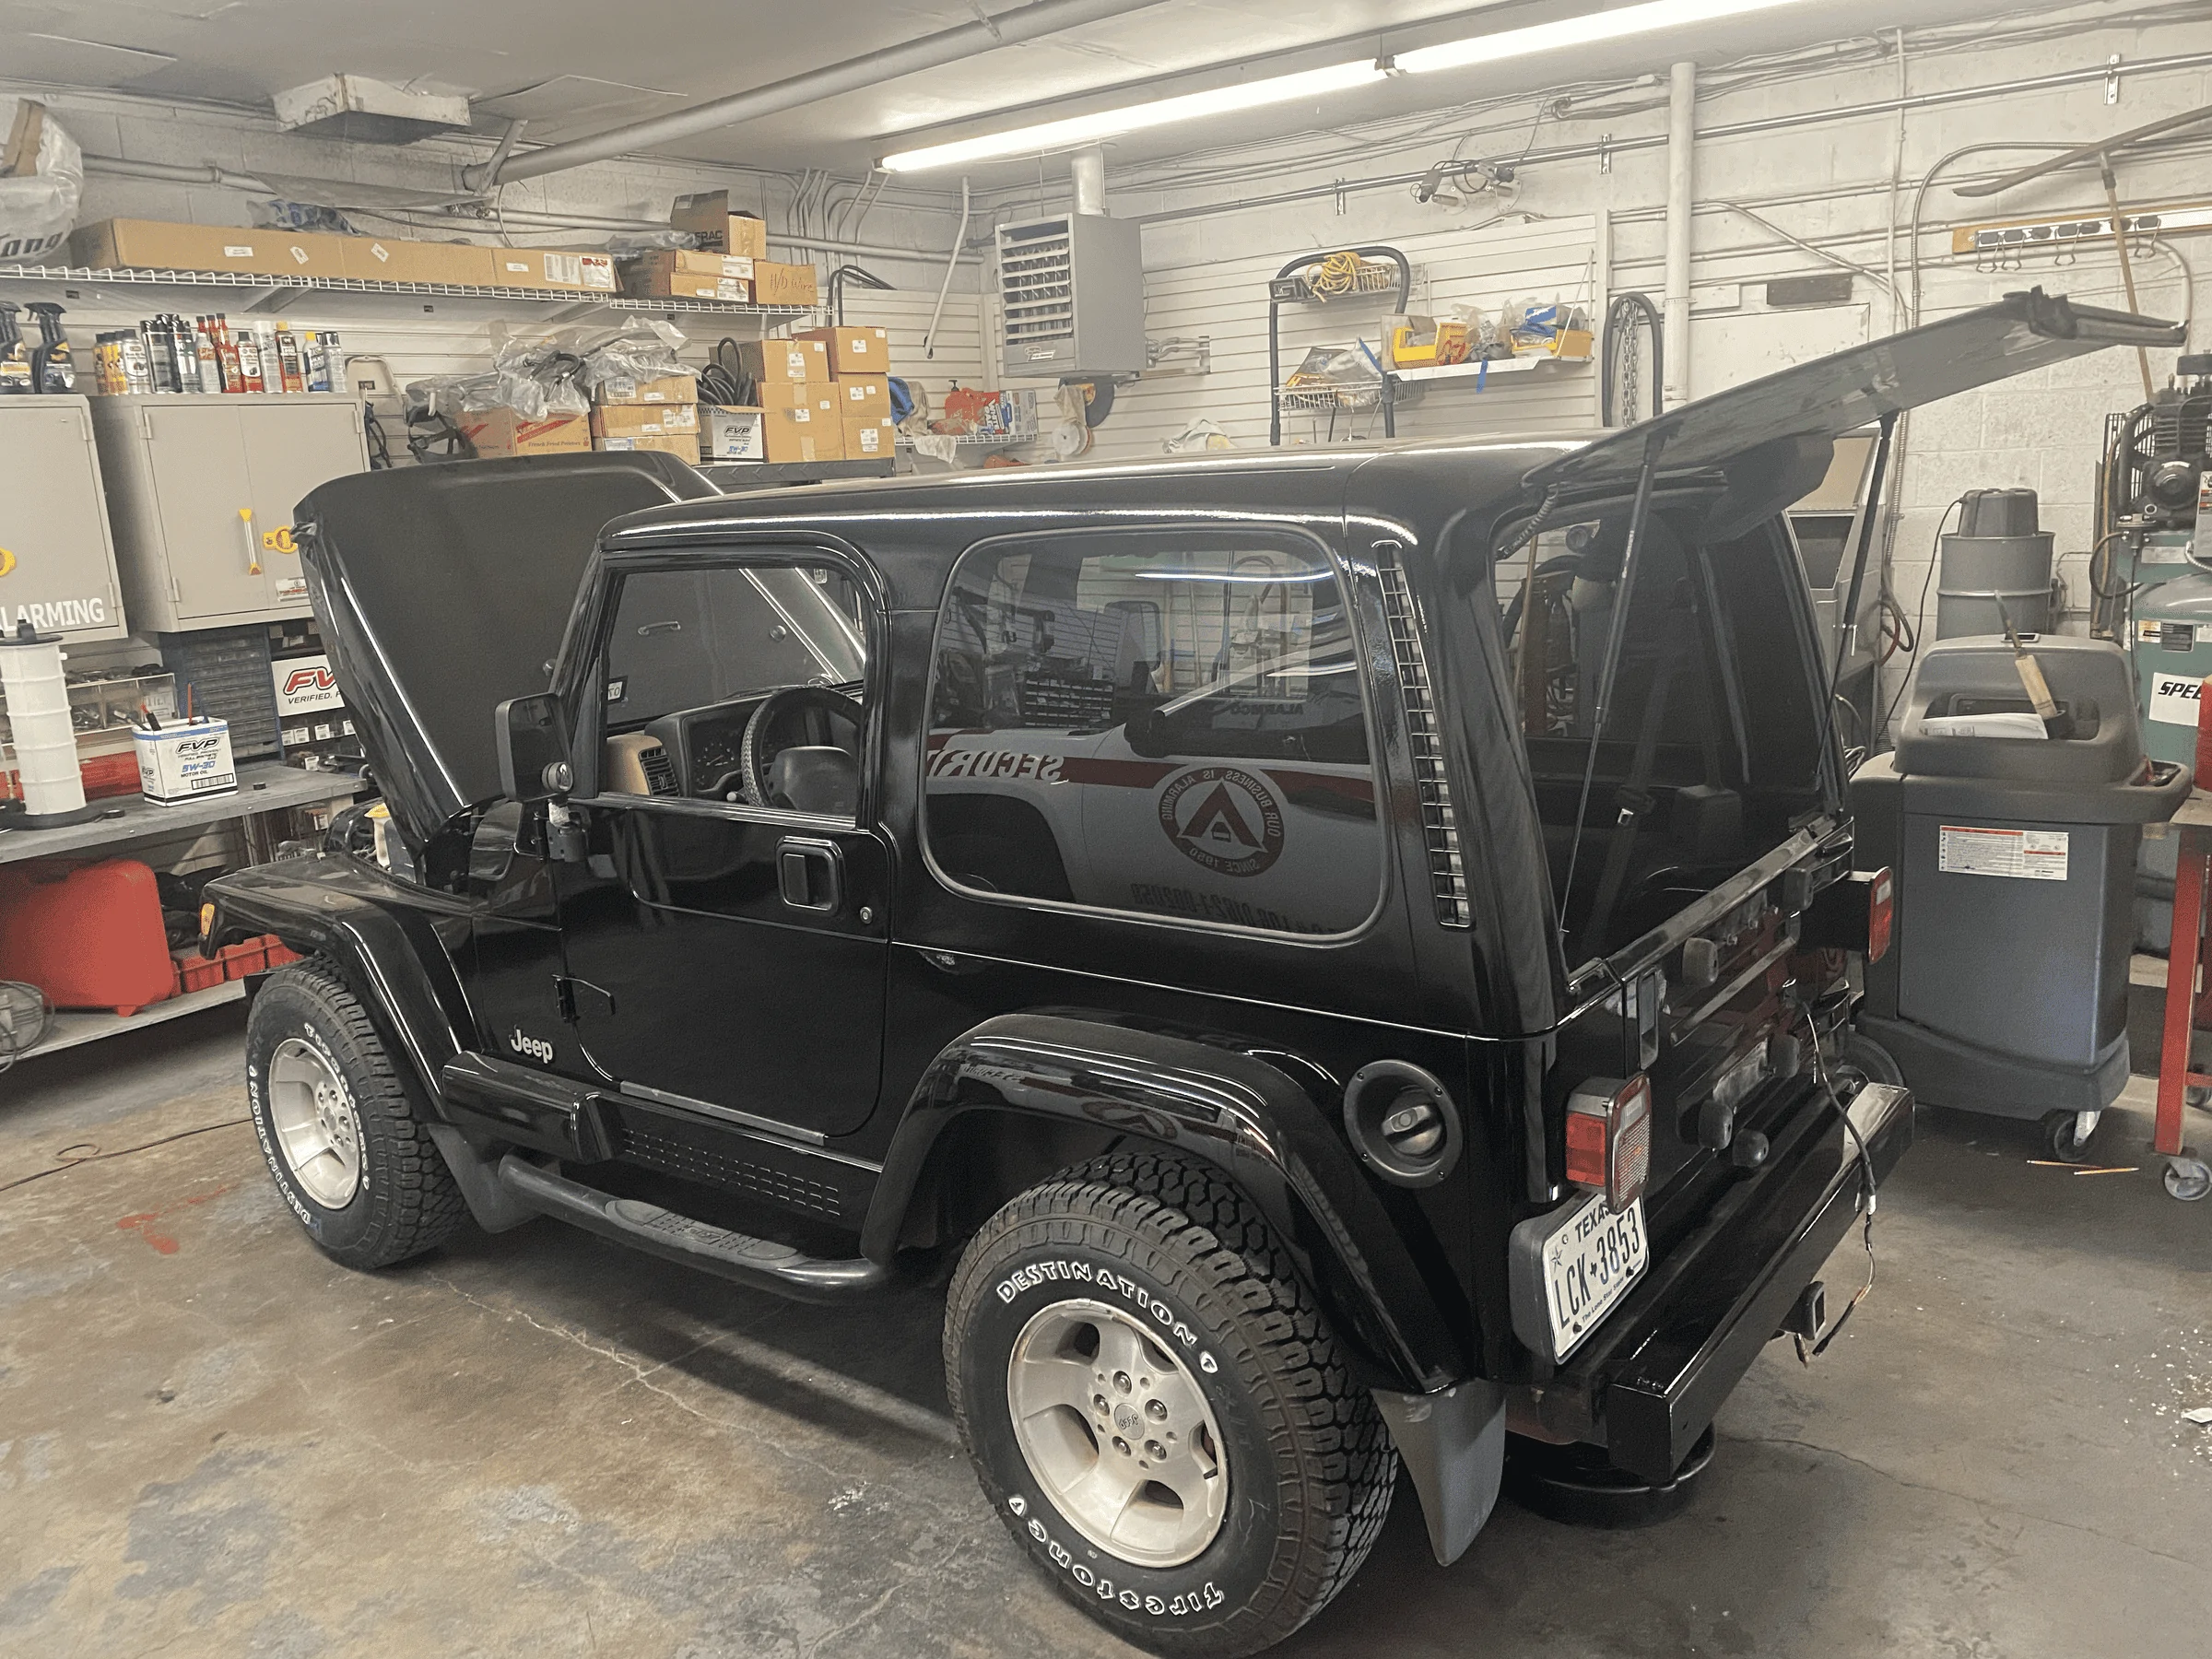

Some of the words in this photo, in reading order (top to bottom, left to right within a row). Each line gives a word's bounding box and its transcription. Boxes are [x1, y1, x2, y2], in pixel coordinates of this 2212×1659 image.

[0, 597, 105, 632] LARMING
[288, 692, 332, 704] VERIFIED.
[177, 738, 218, 753] FVP
[182, 760, 216, 772] 5W-30
[511, 1029, 553, 1064] Jeep
[249, 1080, 311, 1225] DESTINATION
[996, 1260, 1198, 1347] DESTINATION
[1592, 1300, 1603, 1313] Lone
[1603, 1288, 1613, 1300] Star
[1028, 1518, 1224, 1616] Firestone
